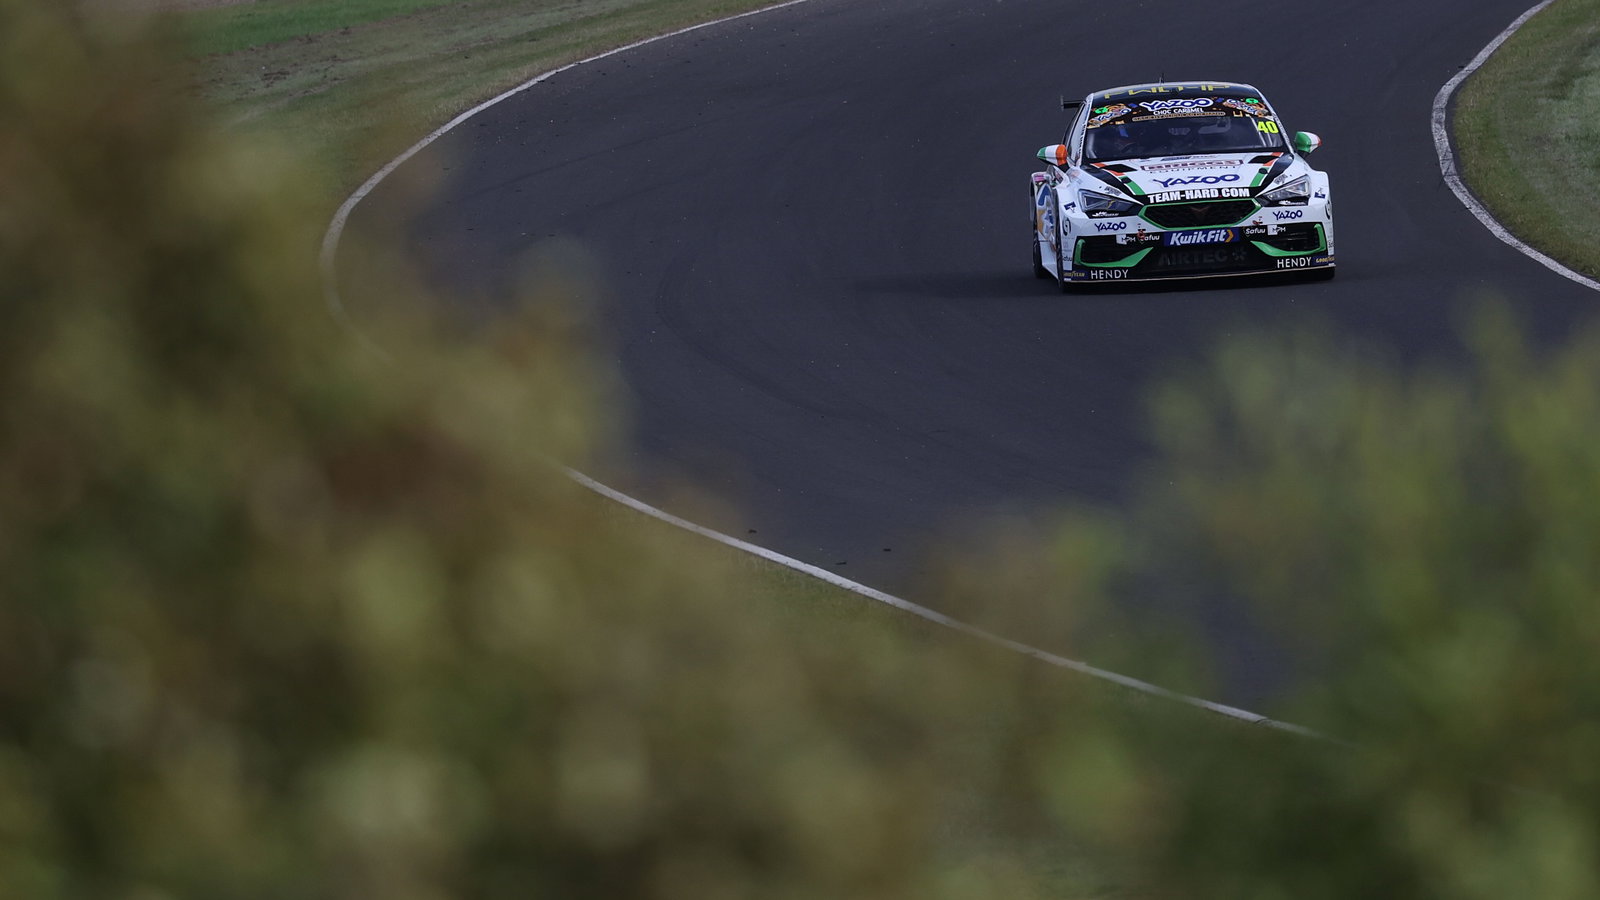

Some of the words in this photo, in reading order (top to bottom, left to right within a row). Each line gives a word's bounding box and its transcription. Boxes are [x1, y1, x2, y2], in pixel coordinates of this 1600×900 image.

[1139, 98, 1213, 111] YAZOO
[1173, 106, 1205, 114] CARAMEL
[1257, 121, 1279, 134] 40
[1153, 174, 1240, 187] YAZOO
[1148, 188, 1249, 204] TEAM-HARD.COM
[1273, 210, 1303, 220] YAZOO
[1094, 221, 1127, 232] YAZOO
[1277, 257, 1312, 269] HENDY
[1090, 269, 1129, 280] HENDY
